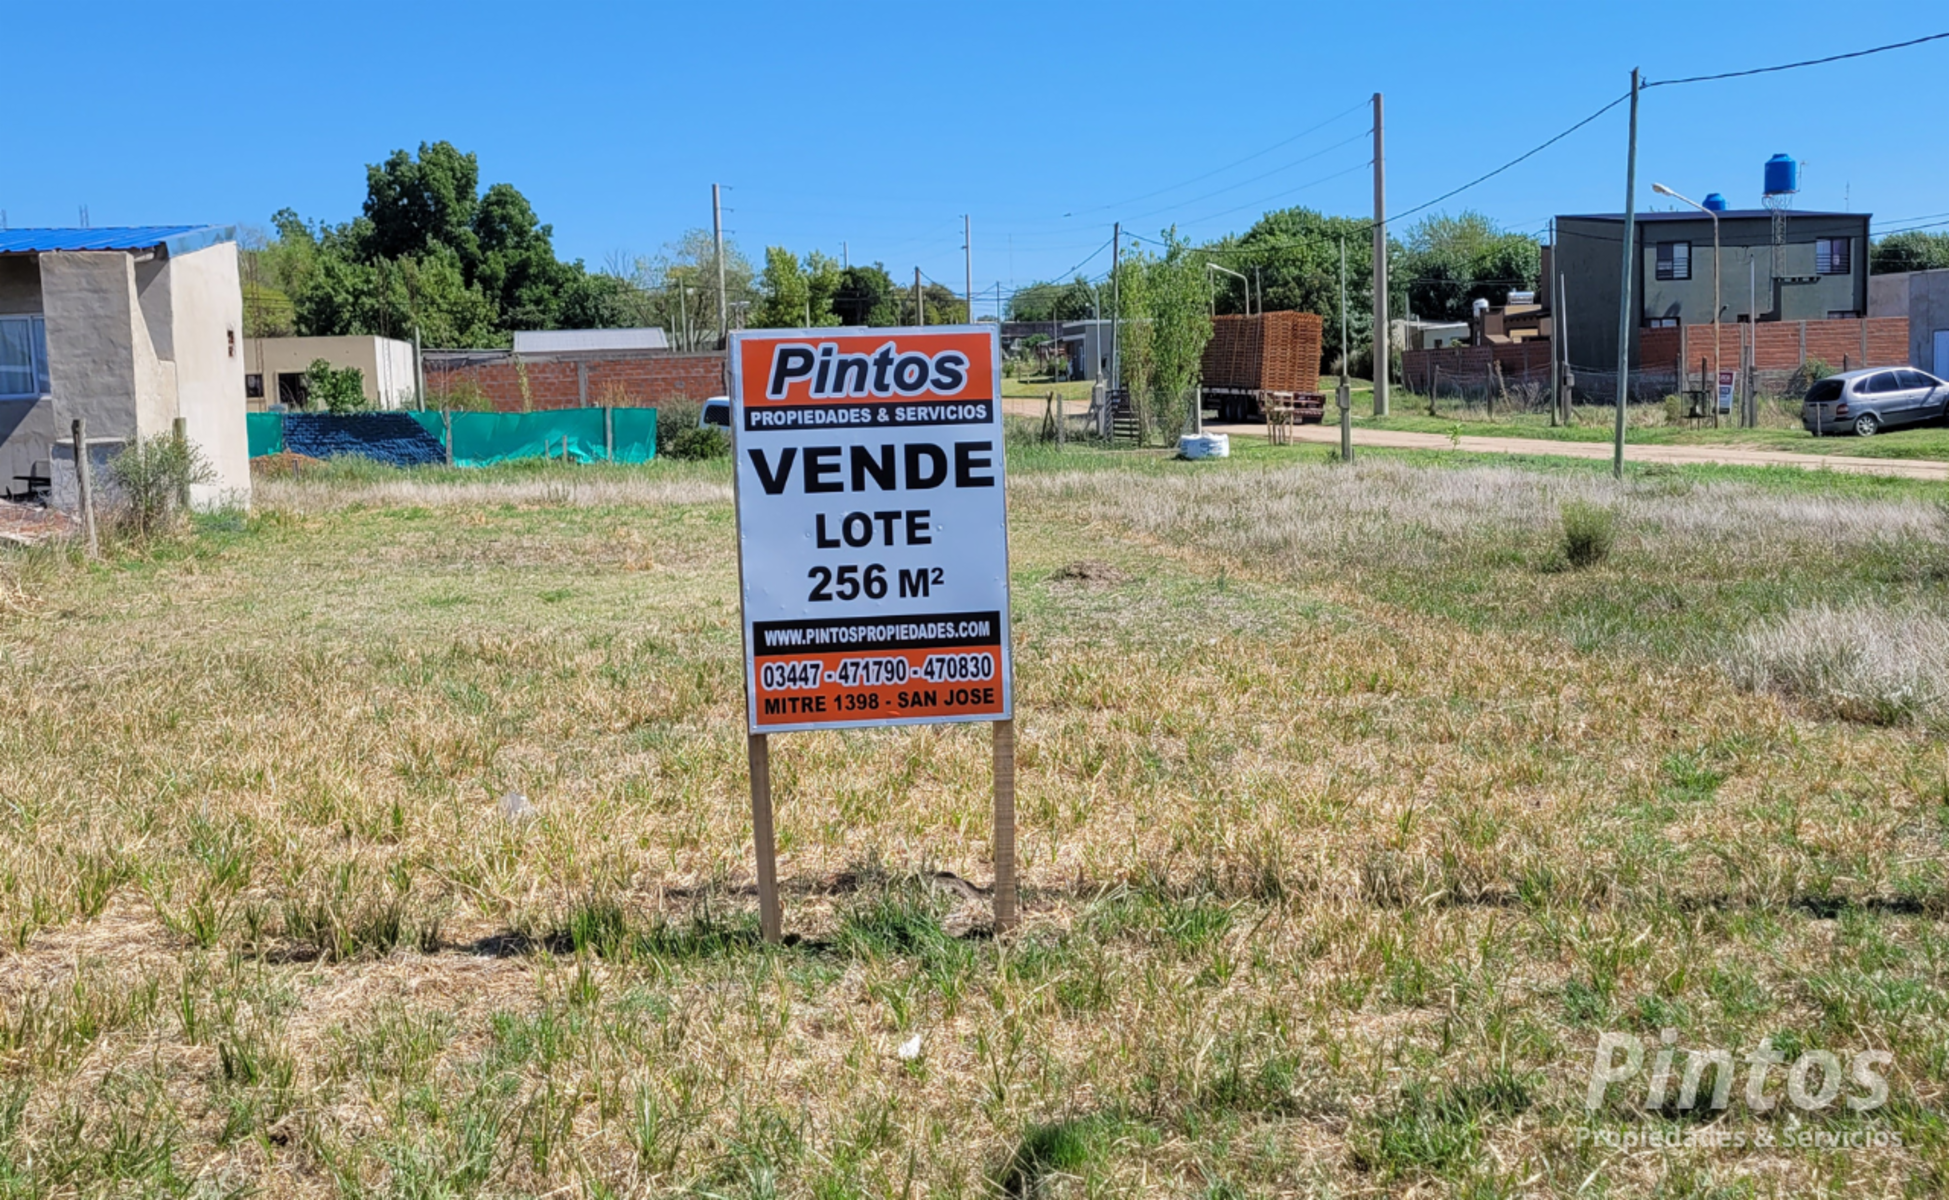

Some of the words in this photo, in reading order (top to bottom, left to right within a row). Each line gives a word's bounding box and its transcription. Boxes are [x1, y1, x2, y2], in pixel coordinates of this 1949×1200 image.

[770, 343, 965, 395] Pintos
[750, 408, 871, 426] PROPIEDADES
[876, 408, 890, 422] &
[895, 404, 987, 421] SERVICIOS
[747, 441, 995, 495] VENDE
[815, 510, 932, 548] LOTE
[807, 563, 888, 602] 256
[764, 621, 990, 646] WWW.PINTOSPROPIEDADES.COM
[764, 696, 826, 715] MITRE
[833, 693, 879, 711] 1398
[897, 690, 937, 708] SAN
[943, 687, 995, 706] JOSE
